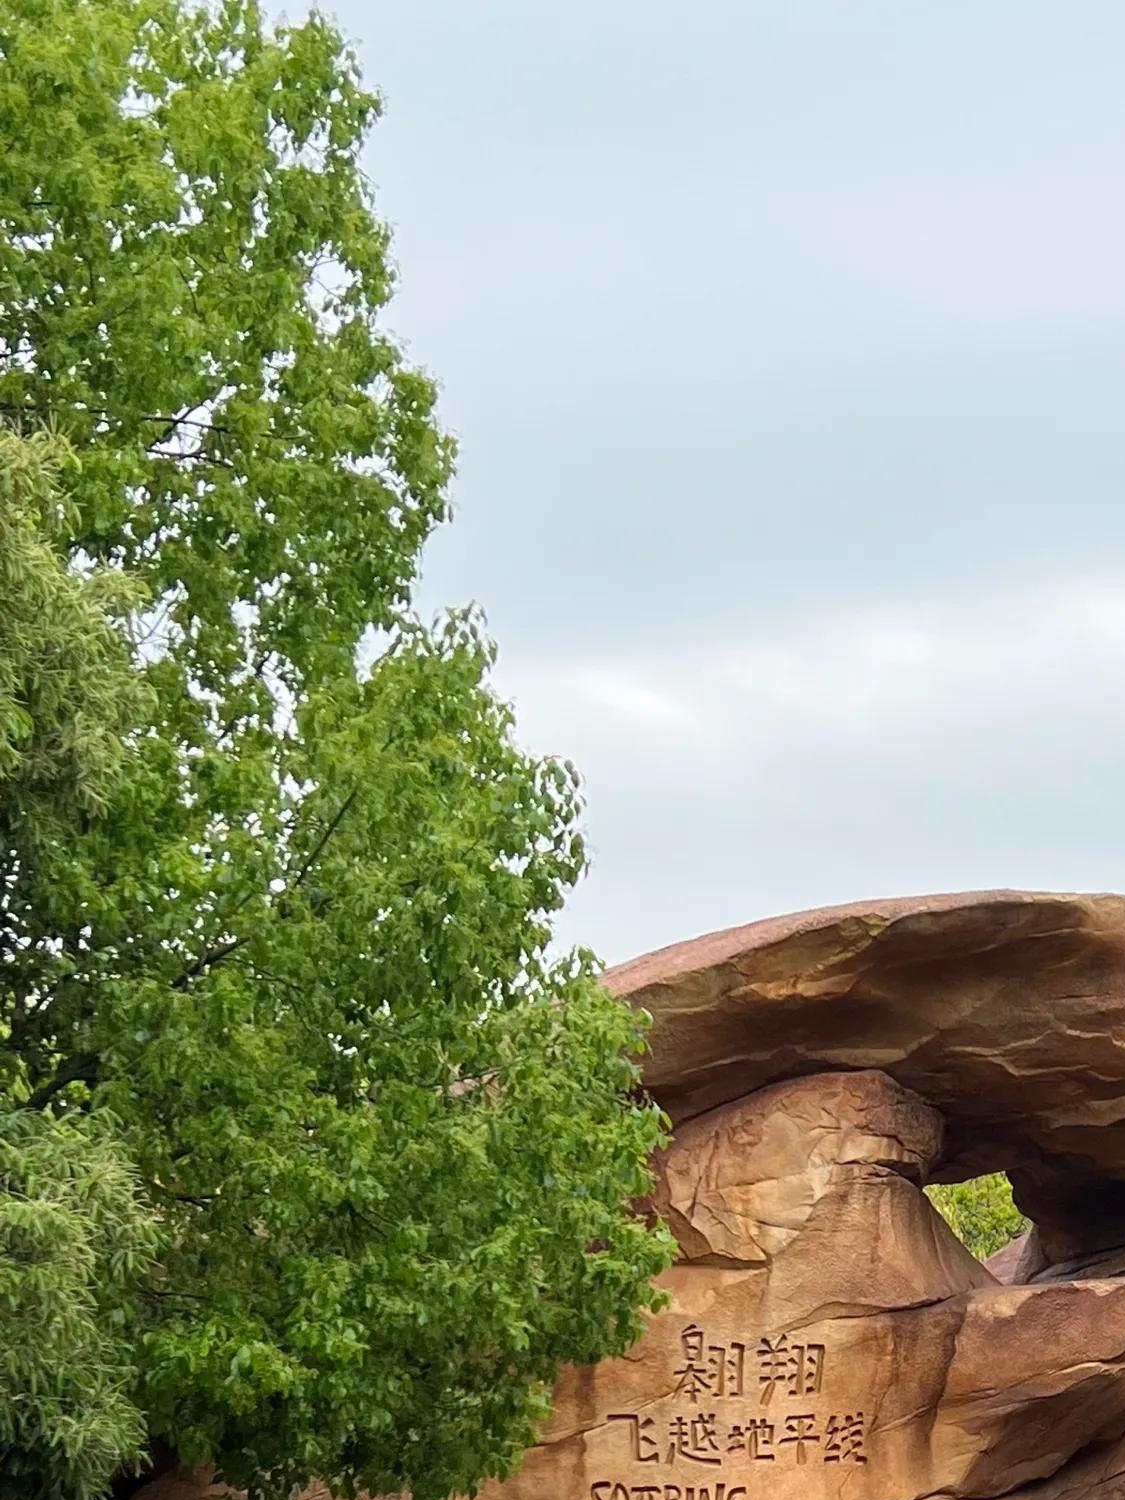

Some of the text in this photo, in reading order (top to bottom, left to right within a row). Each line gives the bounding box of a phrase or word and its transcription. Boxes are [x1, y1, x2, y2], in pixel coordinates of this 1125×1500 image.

[672, 1323, 825, 1406] 翱翔
[606, 1411, 868, 1466] 飞越地平线
